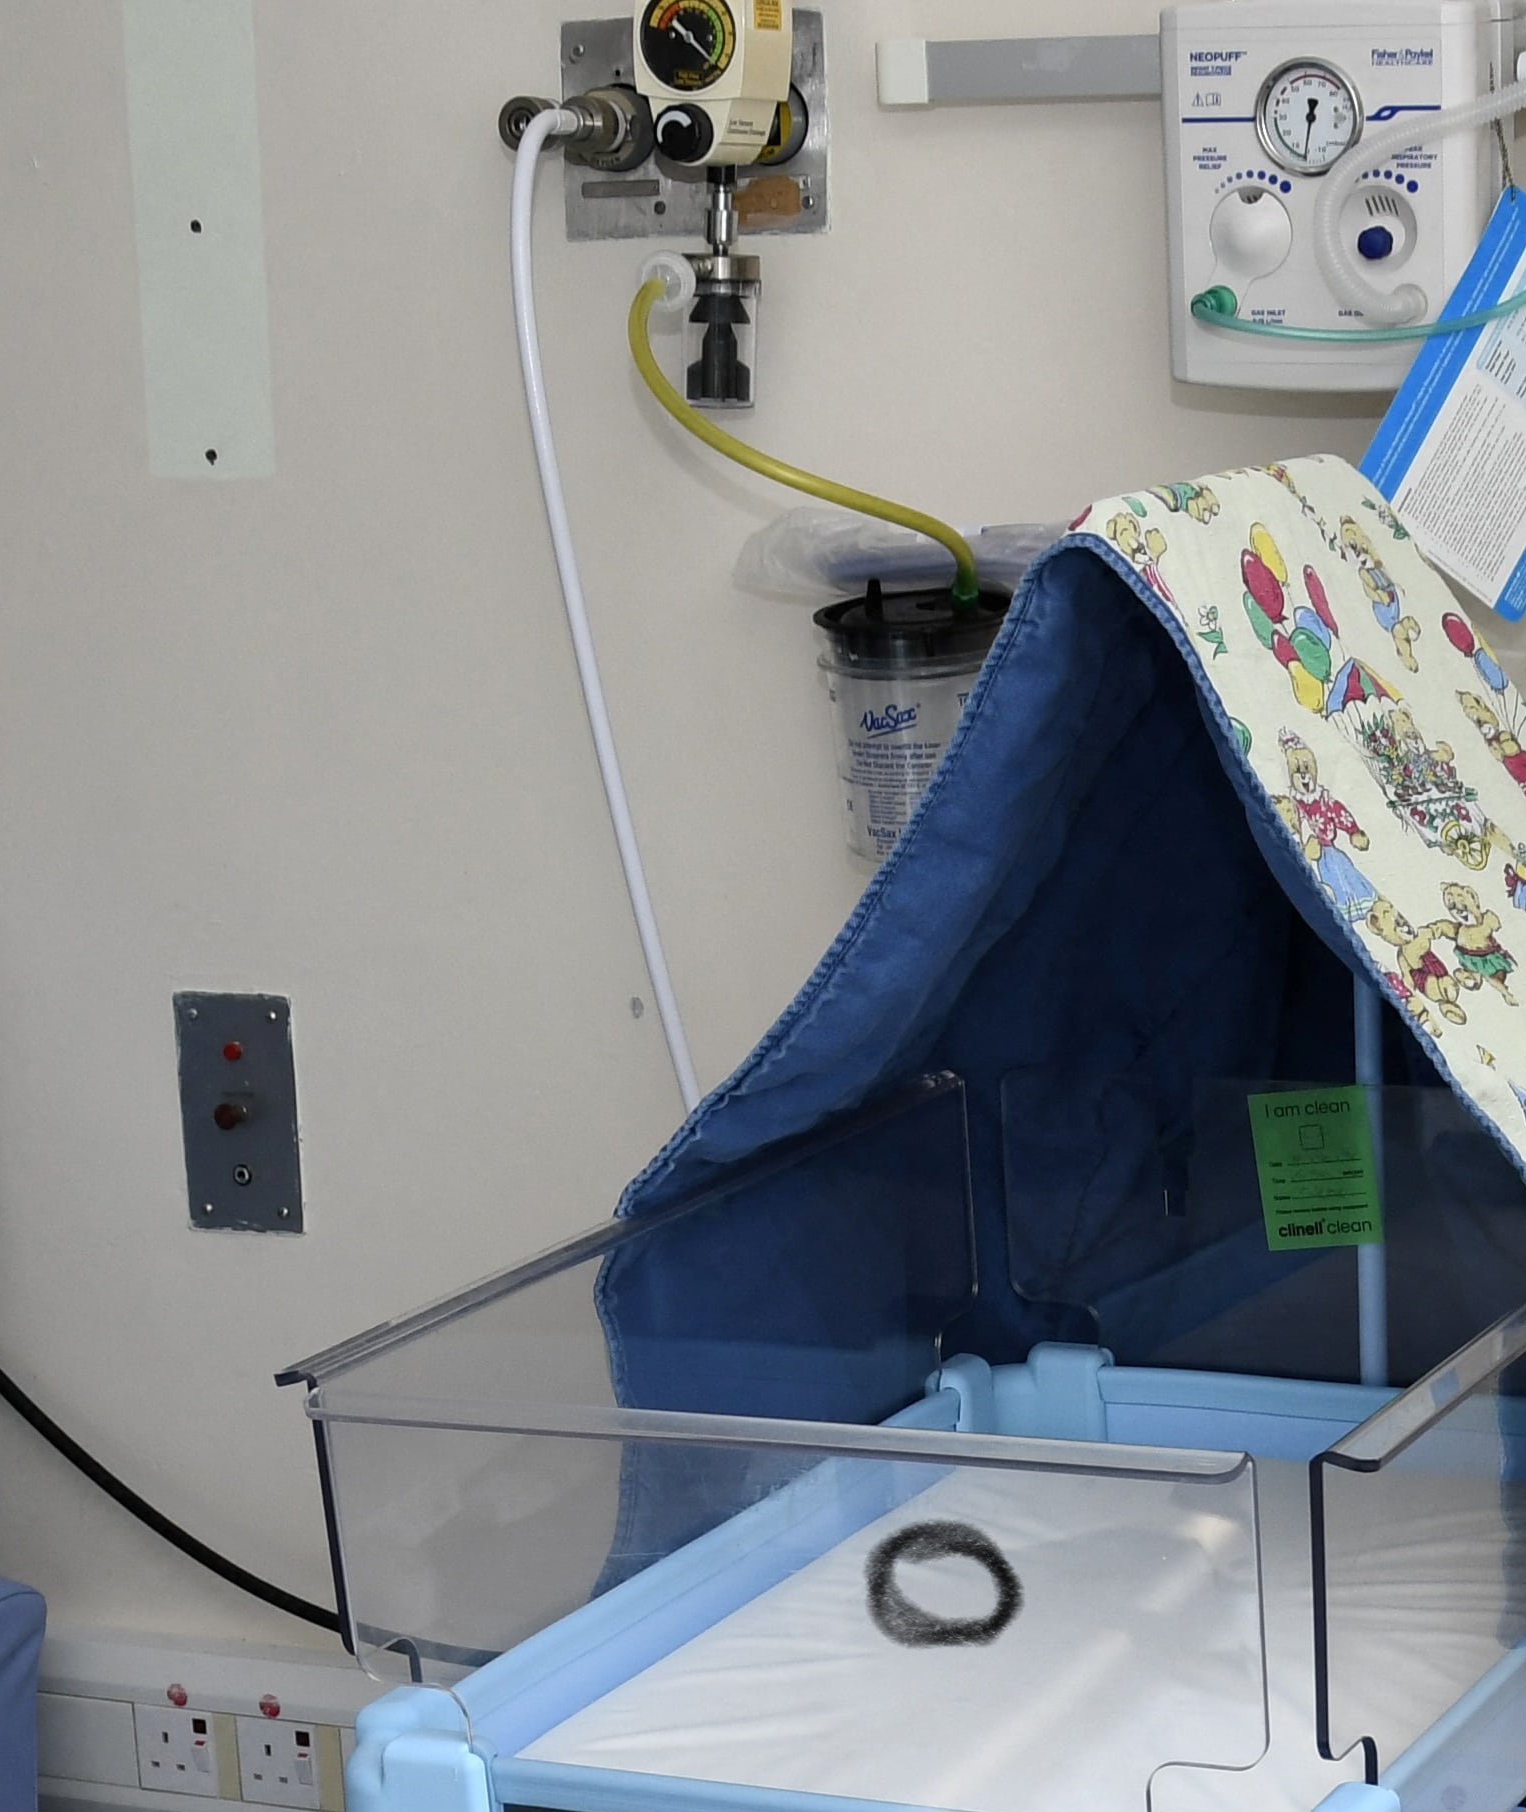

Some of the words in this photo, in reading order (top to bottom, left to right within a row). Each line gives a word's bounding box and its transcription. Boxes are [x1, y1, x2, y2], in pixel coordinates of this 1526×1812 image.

[1190, 52, 1241, 62] NEOPUFF
[1372, 49, 1397, 59] Fisher
[1405, 48, 1433, 60] Paykel
[860, 704, 917, 732] VacSax
[1274, 1105, 1300, 1118] am
[1304, 1100, 1351, 1115] clean
[1278, 1221, 1323, 1238] clinell
[1327, 1220, 1372, 1234] clean
